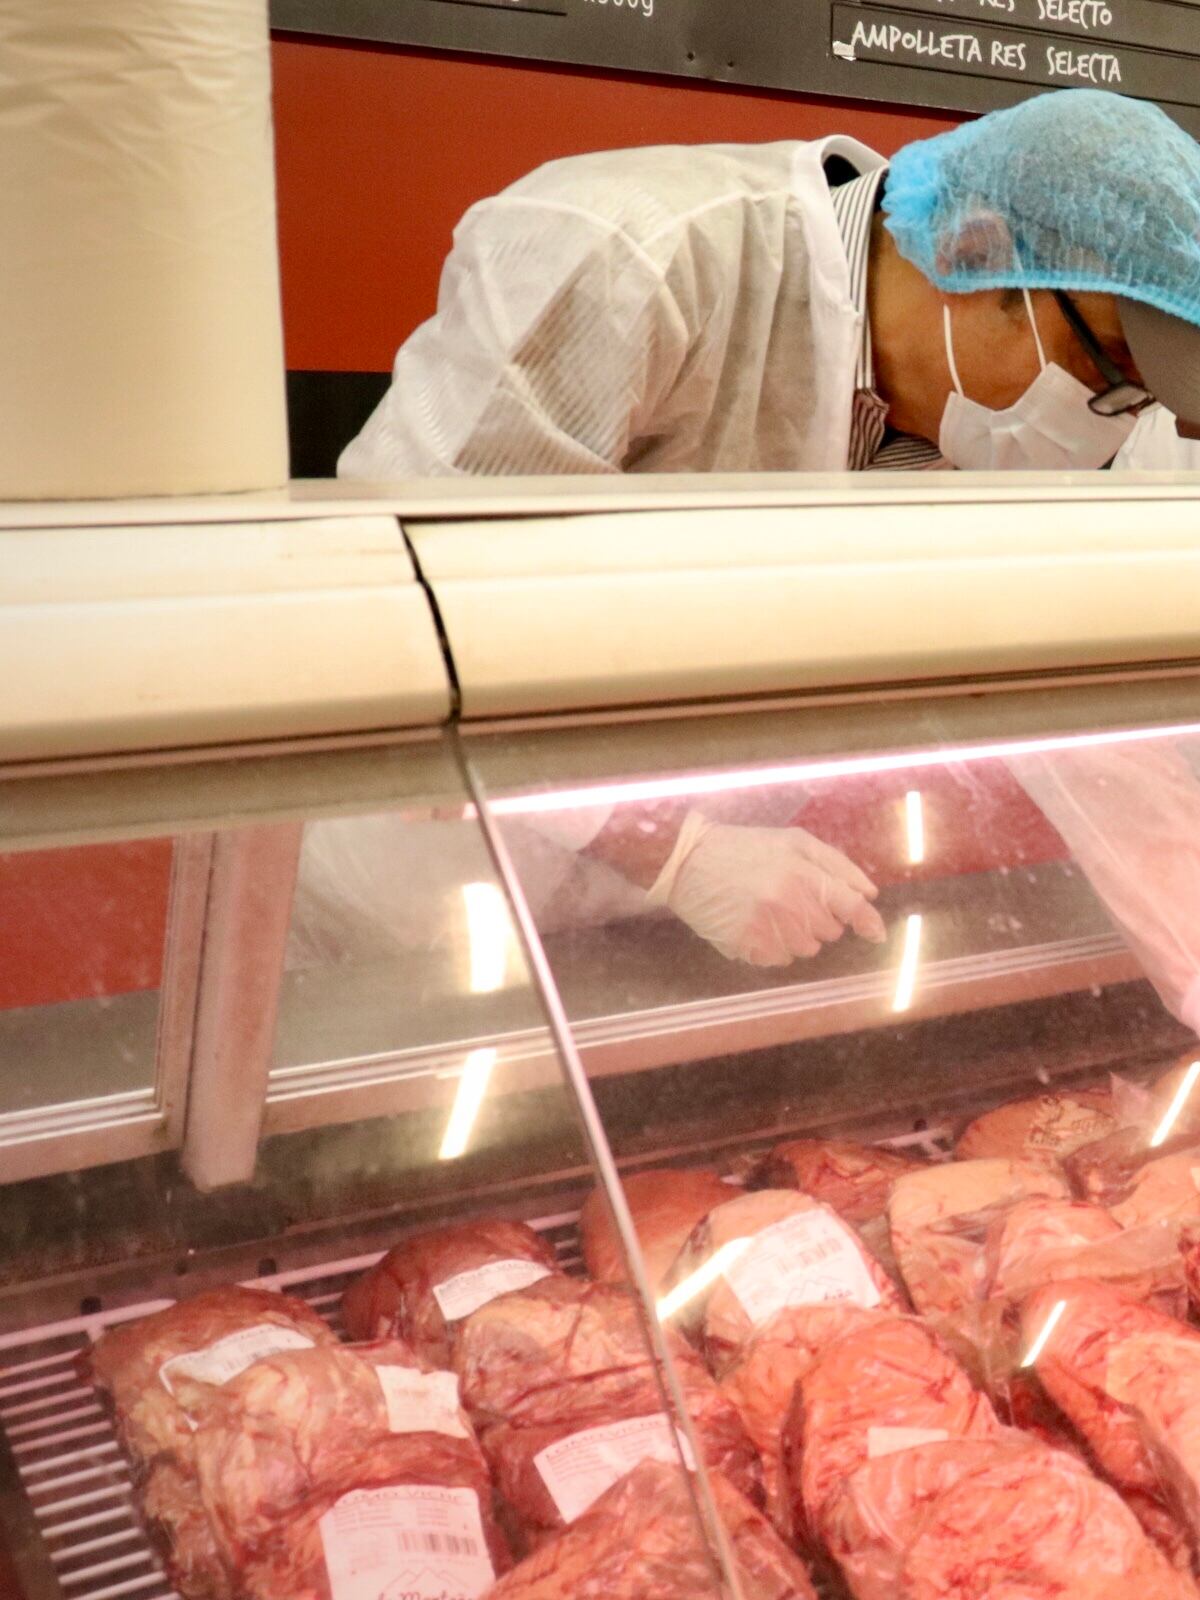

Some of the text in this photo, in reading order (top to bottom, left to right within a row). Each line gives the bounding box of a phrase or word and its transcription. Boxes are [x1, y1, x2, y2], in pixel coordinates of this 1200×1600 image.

[1037, 0, 1113, 29] SELECTO
[851, 21, 1122, 83] AMPOLLETA RES SELECTA
